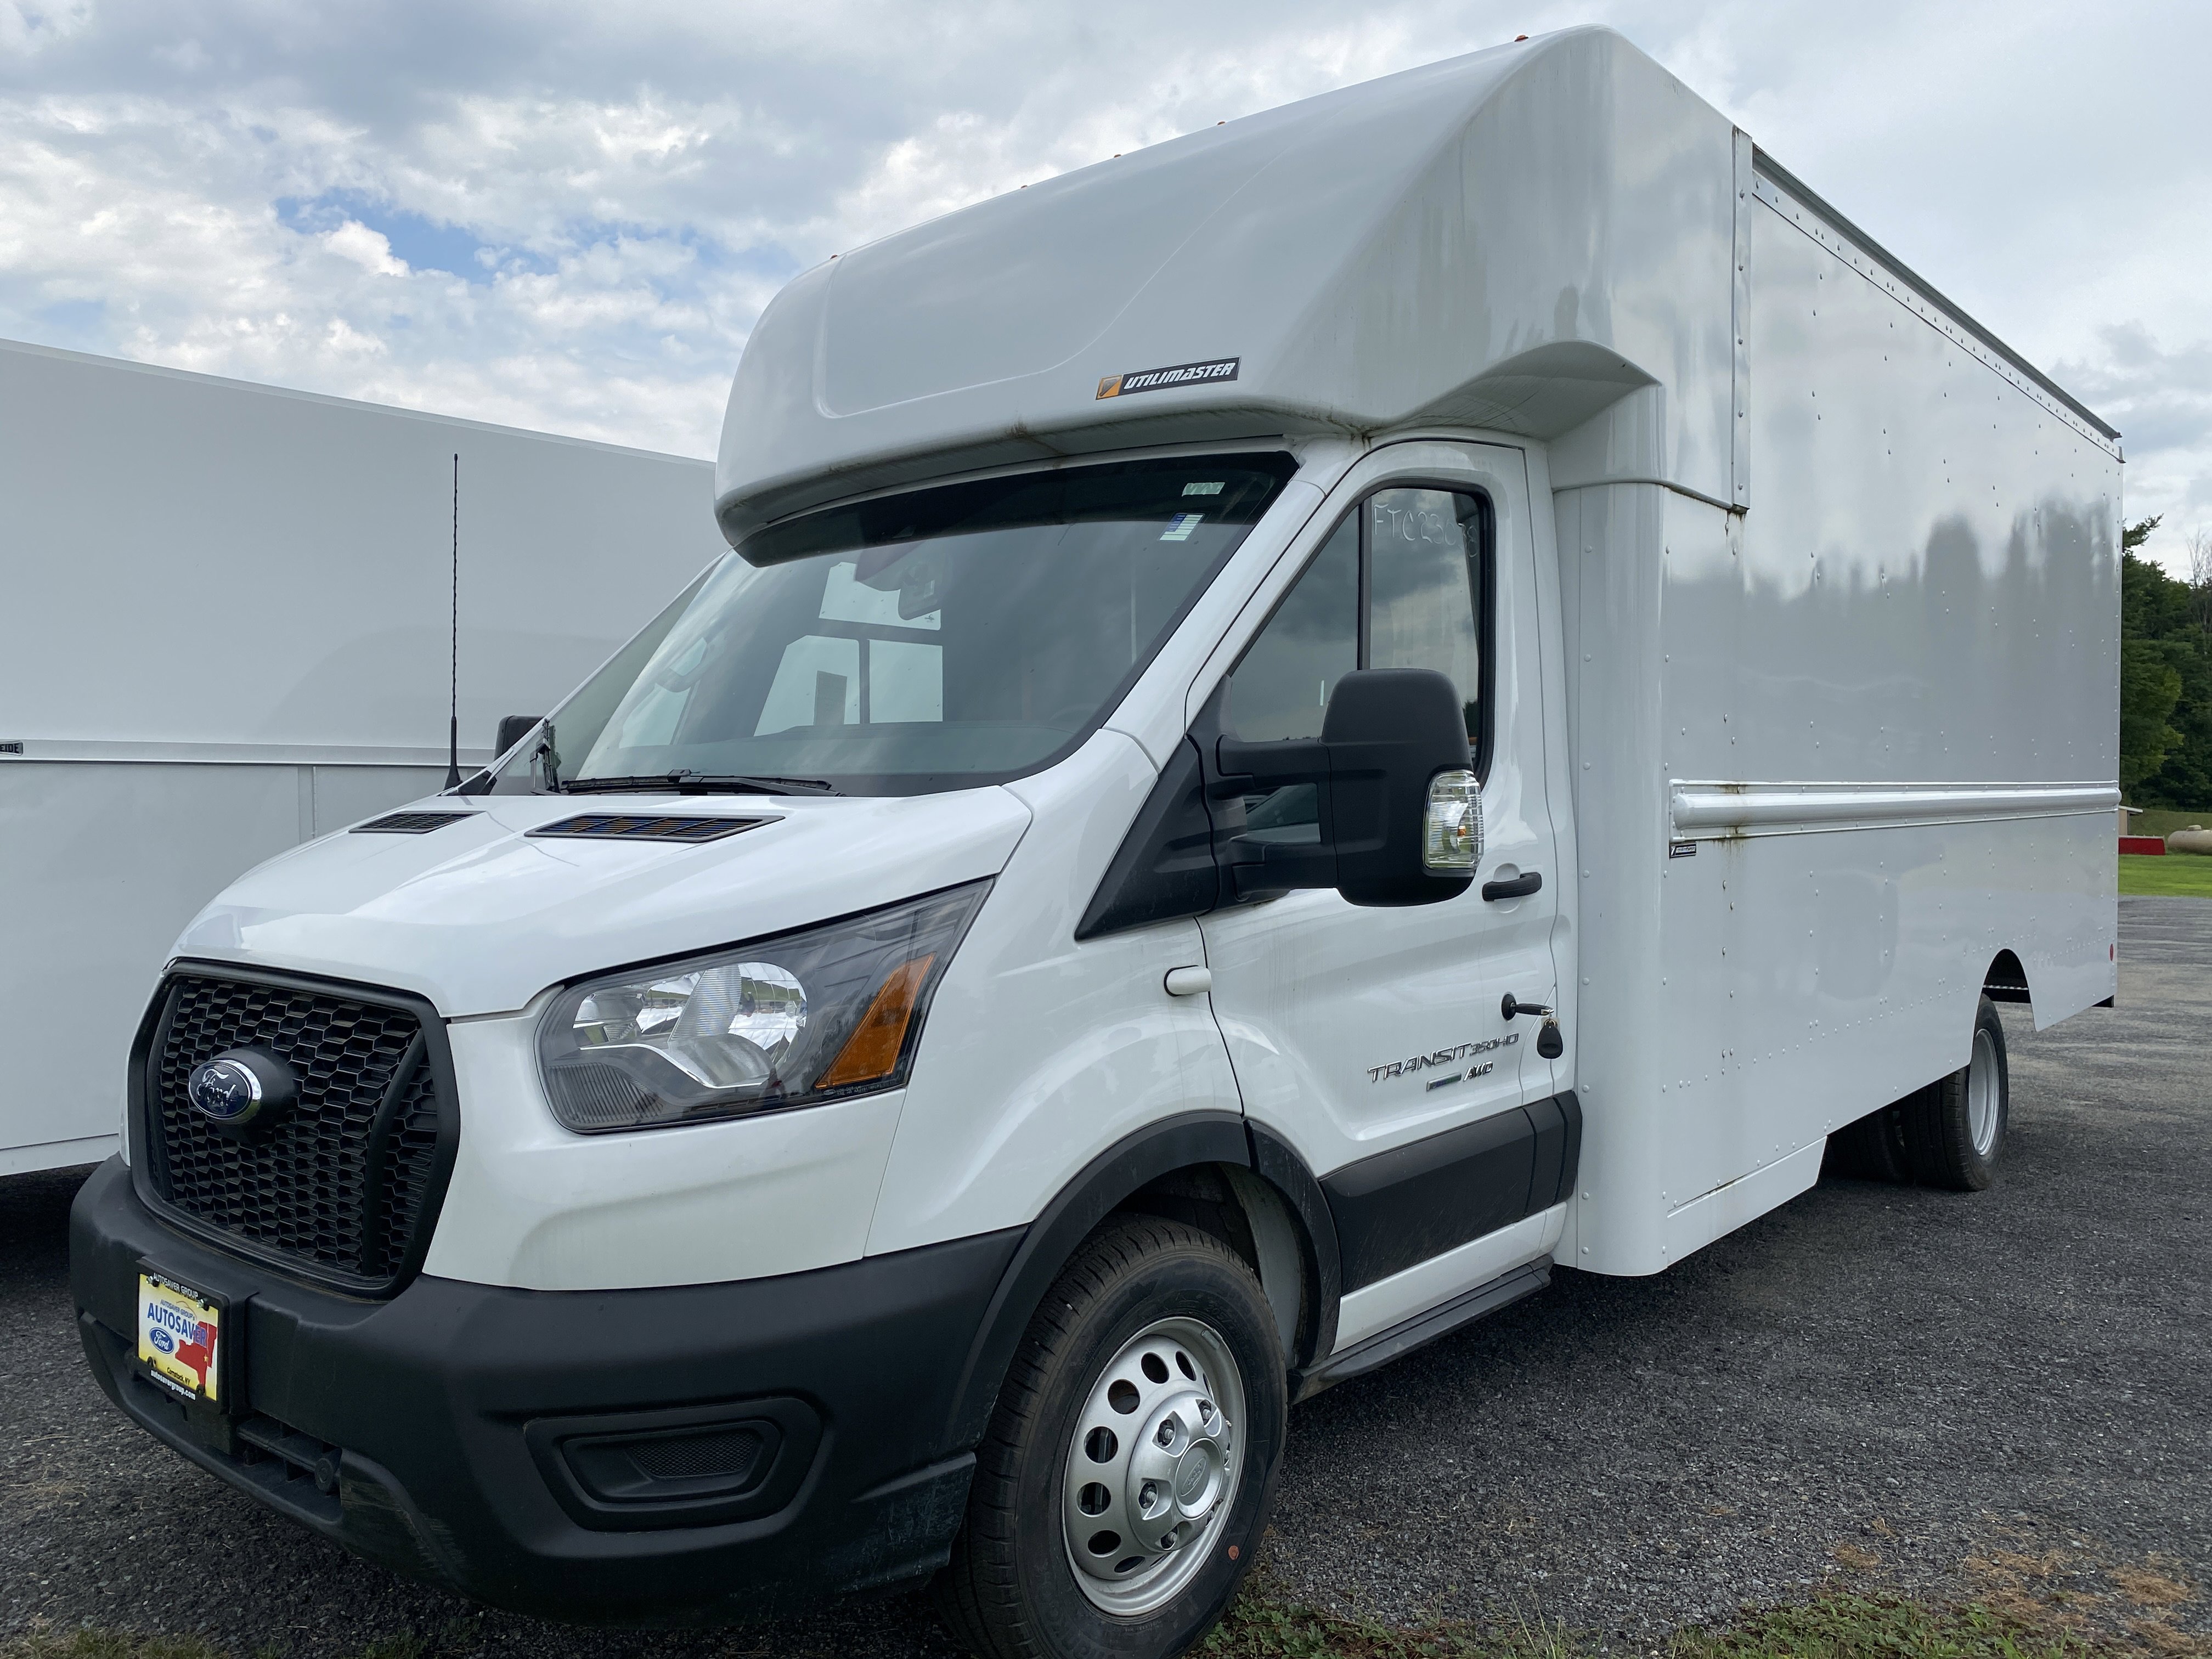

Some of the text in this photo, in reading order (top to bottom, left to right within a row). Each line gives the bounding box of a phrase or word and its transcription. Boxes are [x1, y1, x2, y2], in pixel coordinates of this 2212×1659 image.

[1124, 362, 1236, 390] UTILIMASTER
[1367, 1042, 1471, 1083] TRANSIT
[1463, 1060, 1493, 1082] AWD
[196, 1068, 237, 1106] Ford
[154, 1272, 199, 1300] AUTOSAVER GROUP
[147, 1302, 207, 1348] AUTOSAVER
[154, 1330, 170, 1350] Ford
[167, 1367, 191, 1386] Comstock, NY
